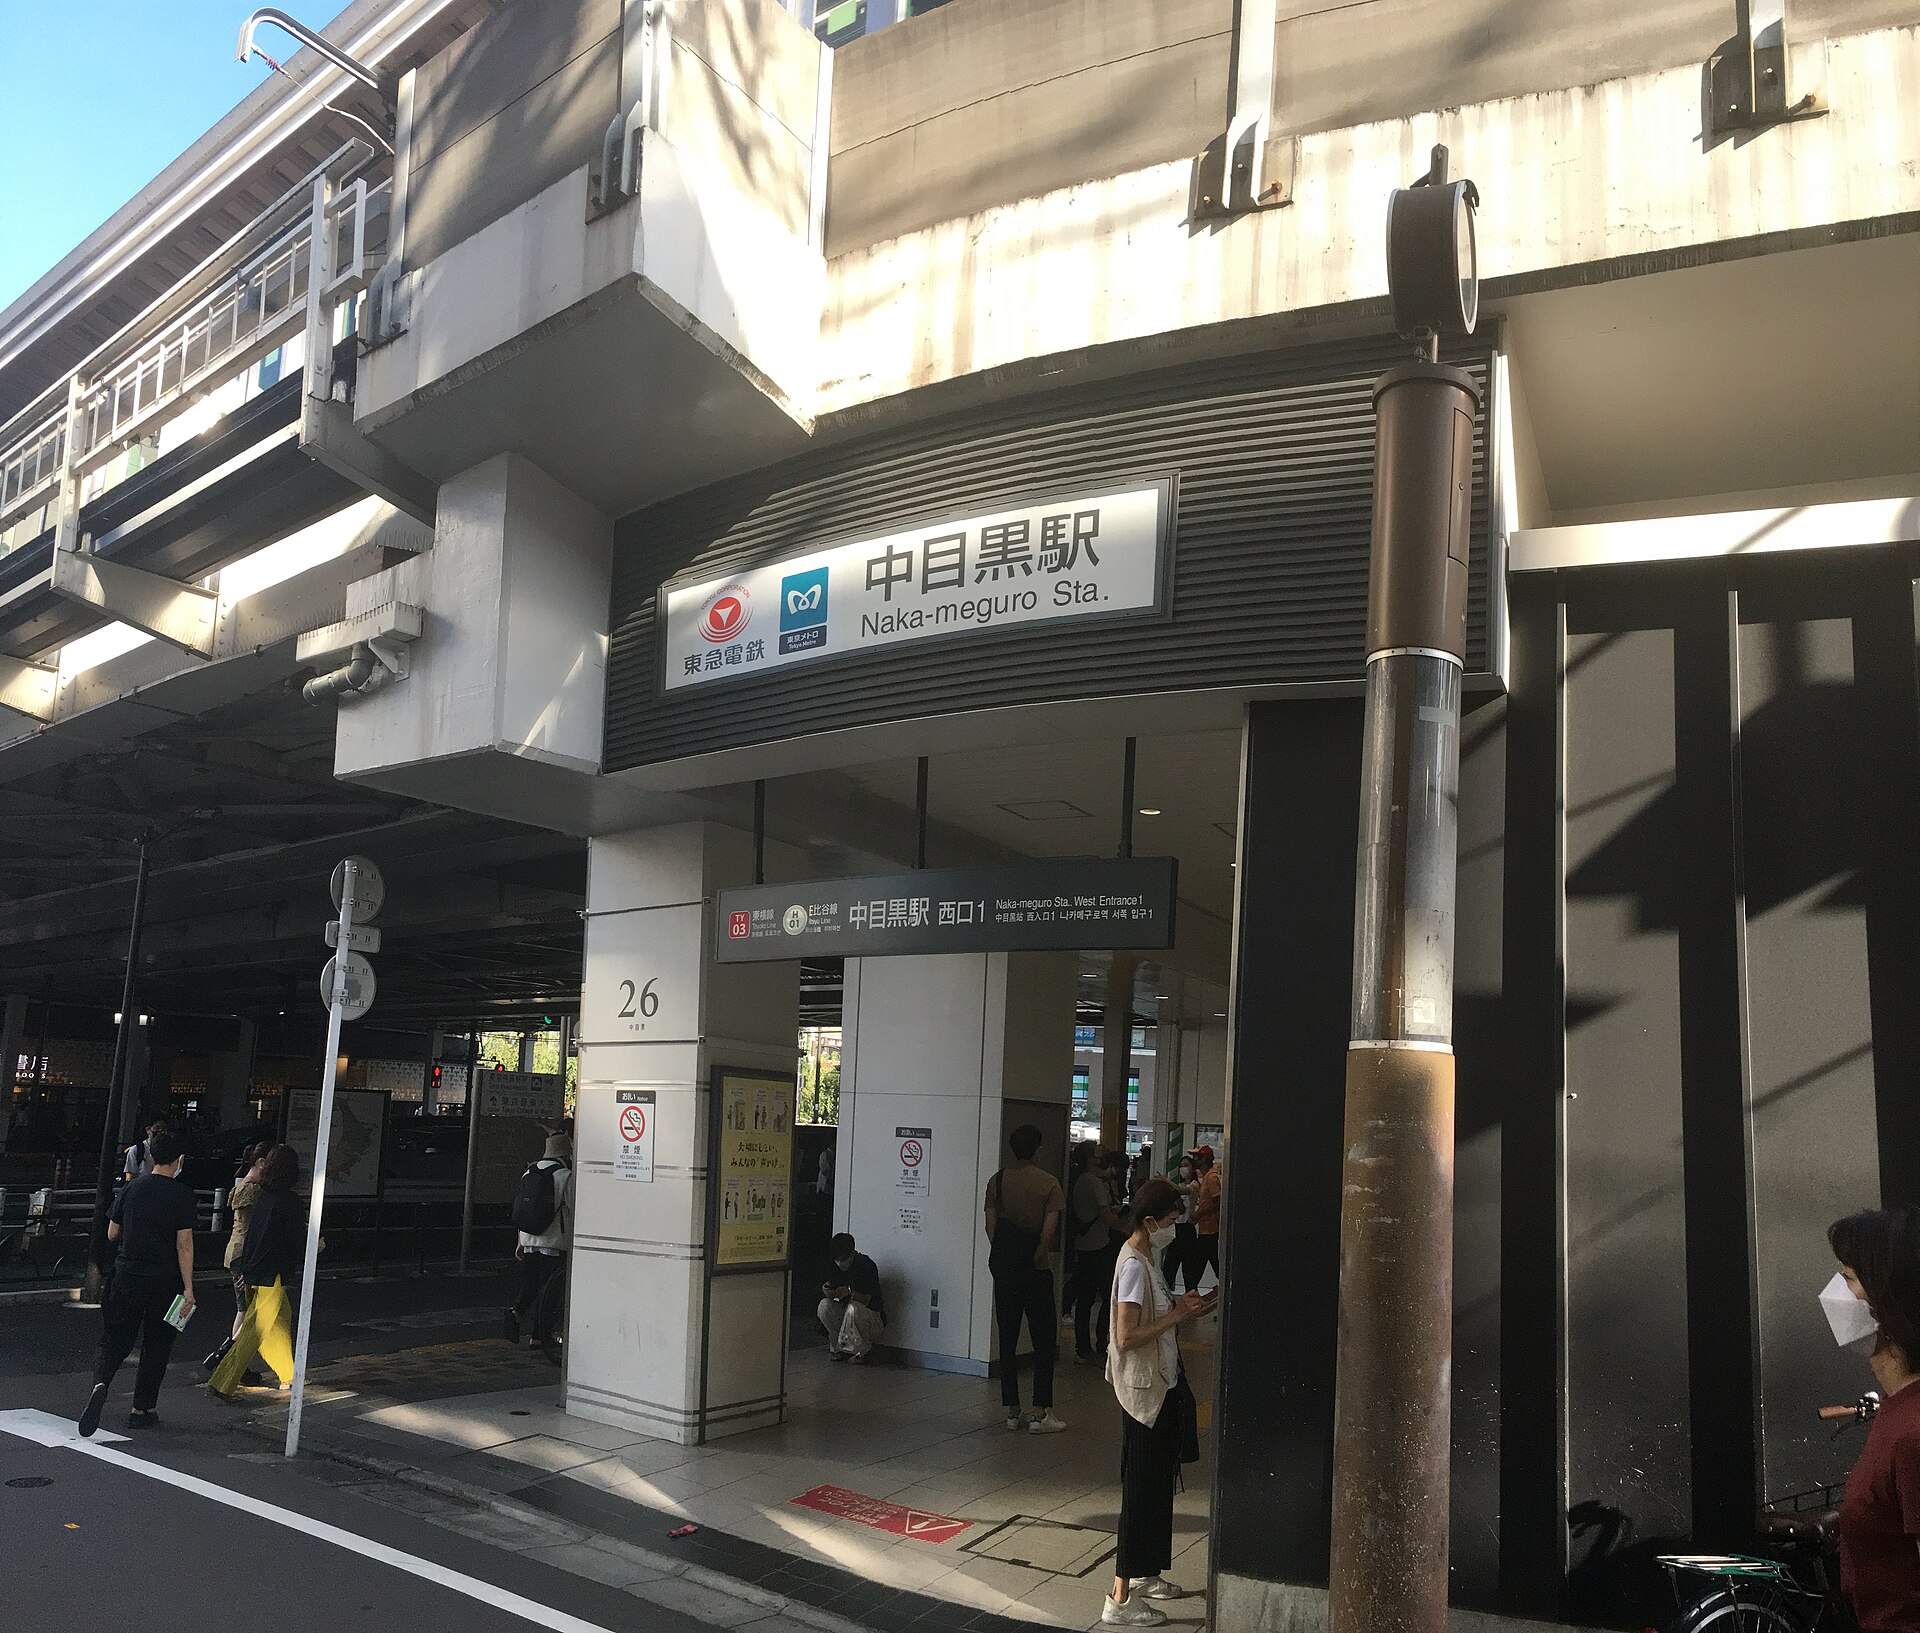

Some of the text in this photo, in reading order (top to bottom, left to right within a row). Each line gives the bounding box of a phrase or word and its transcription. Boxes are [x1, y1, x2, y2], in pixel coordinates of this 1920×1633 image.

[865, 508, 1100, 602] 中目黒駅
[861, 580, 1109, 638] Naka-meguro Sta.
[786, 630, 819, 645] 東京メトロ
[683, 638, 765, 676] 東急電鉄
[995, 898, 1052, 910] Naka-meguro
[1053, 896, 1073, 908] Sta.
[1073, 895, 1096, 907] West
[734, 912, 746, 923] TY
[792, 910, 799, 918] H
[849, 897, 930, 930] 中目黒駅
[732, 923, 747, 936] 03
[789, 919, 800, 929] 01
[617, 976, 659, 1018] 26
